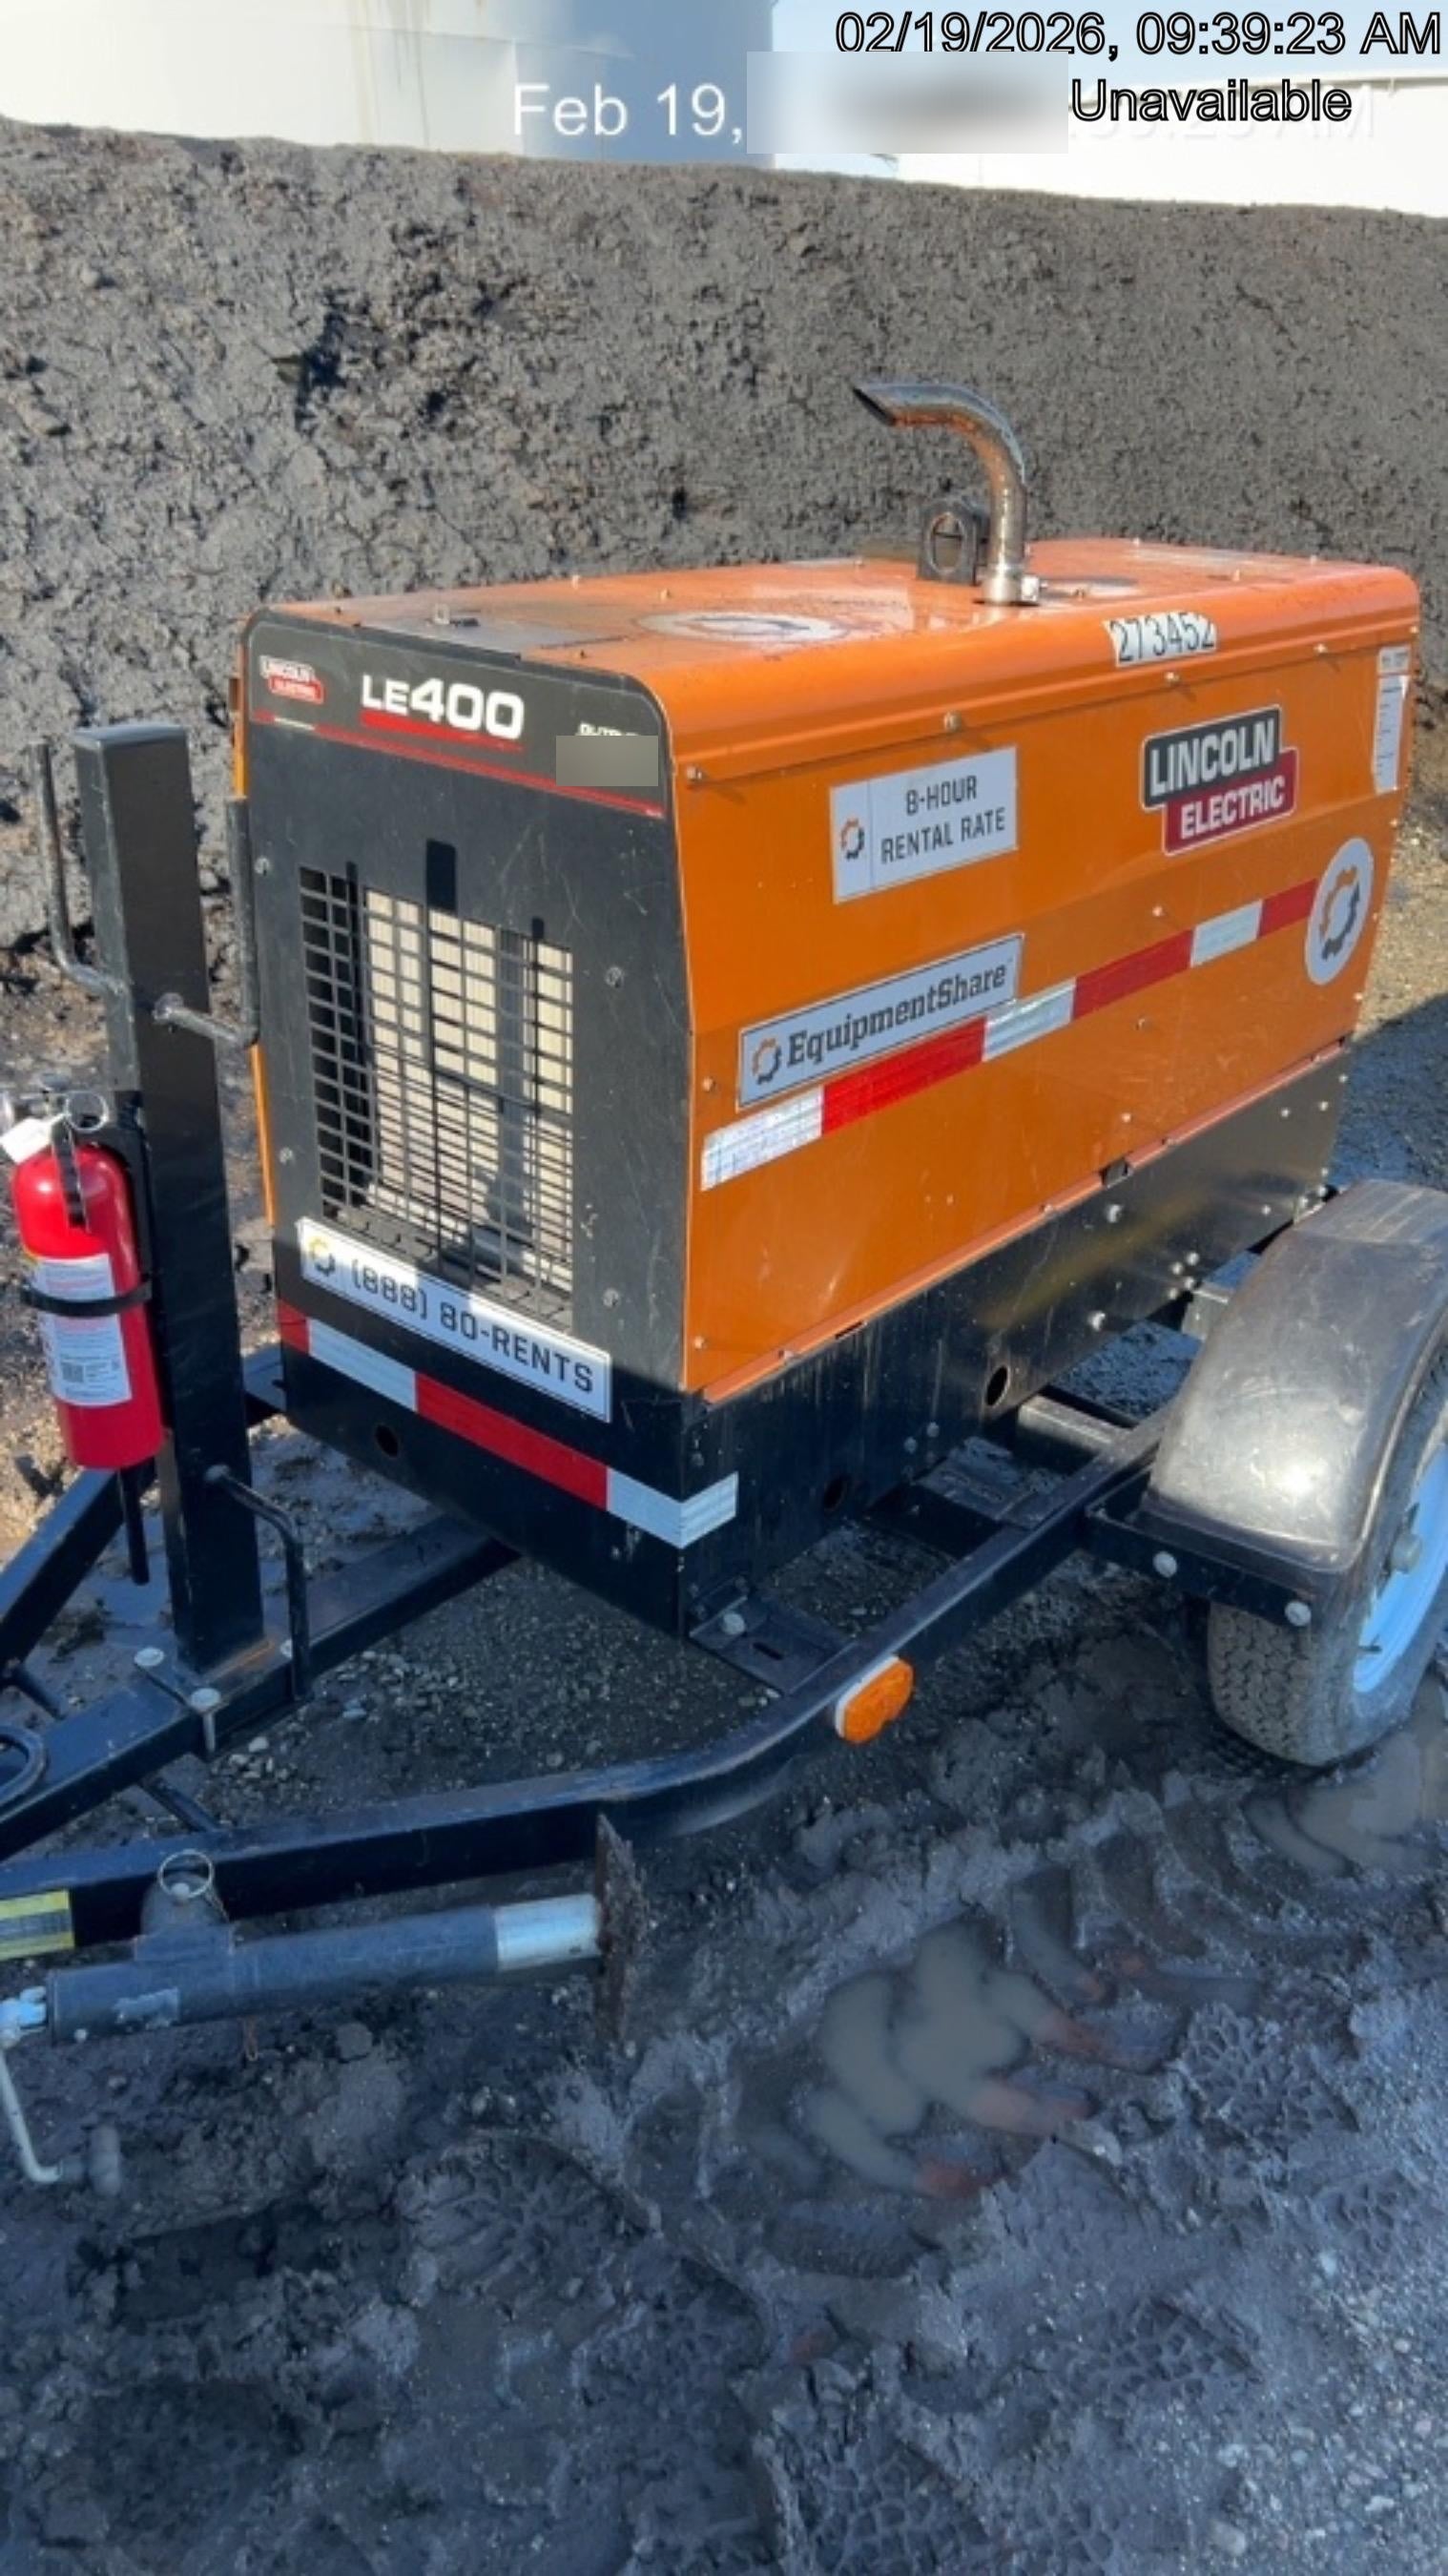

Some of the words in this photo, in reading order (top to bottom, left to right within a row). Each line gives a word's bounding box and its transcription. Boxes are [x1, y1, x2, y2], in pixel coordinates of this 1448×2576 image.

[1109, 612, 1214, 662] 273452
[362, 674, 525, 739] LE400
[1150, 717, 1276, 796] LINCOLN
[906, 775, 977, 815] 8-HOUR
[1181, 775, 1286, 840] ELECTRIC
[880, 823, 954, 863] RENTAL
[961, 806, 1005, 842] RATE
[787, 963, 1006, 1067] EquipmentShare
[352, 1258, 428, 1319] (888)
[440, 1302, 592, 1392] 80-RENTS
